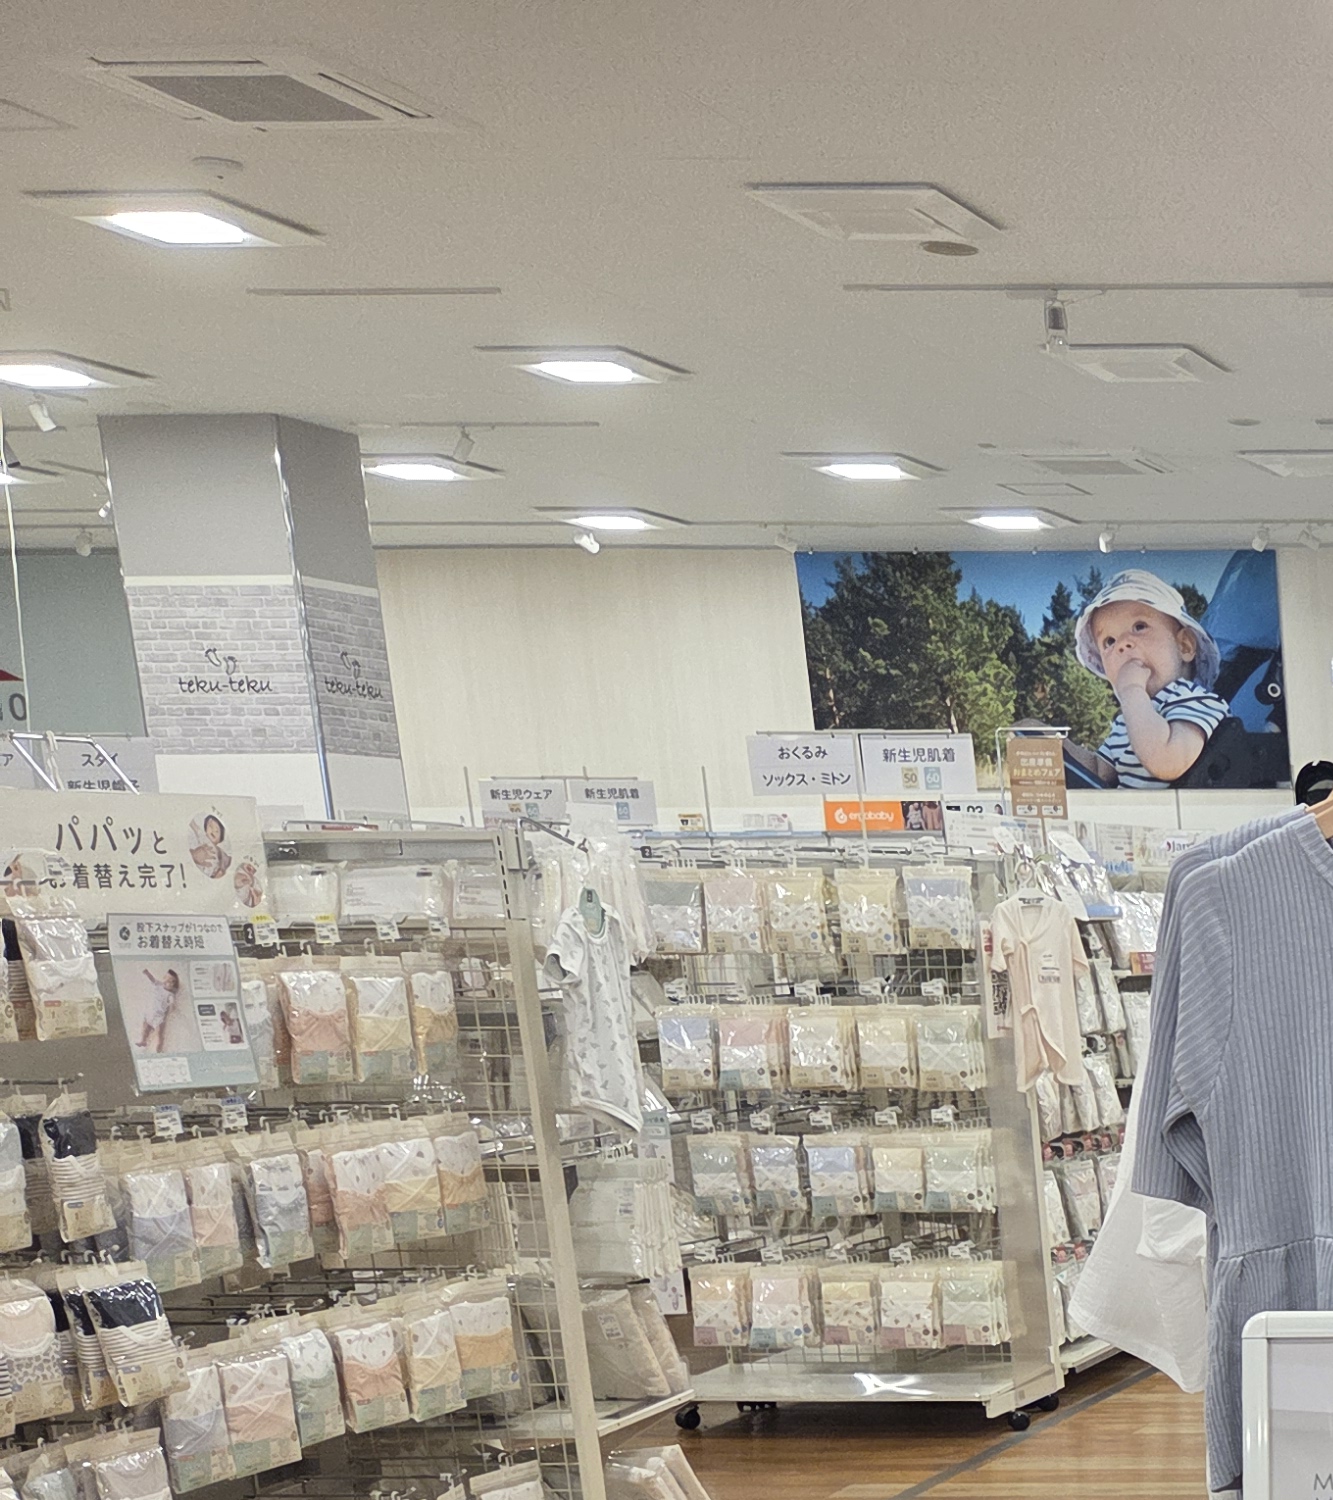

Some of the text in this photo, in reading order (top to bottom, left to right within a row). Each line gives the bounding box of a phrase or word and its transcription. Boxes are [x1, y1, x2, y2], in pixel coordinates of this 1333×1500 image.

[178, 676, 273, 694] teku-teku
[324, 677, 384, 699] teku-teku
[81, 752, 118, 767] スタイ
[777, 745, 829, 760] おくるみ
[882, 747, 956, 763] 新生児肌着
[762, 772, 851, 787] ソックス・ミトン
[903, 773, 918, 784] 50
[925, 771, 940, 784] 60
[490, 788, 553, 800] 新生児ウェア
[584, 787, 640, 800] 新生児肌着
[55, 814, 168, 855] パパッと
